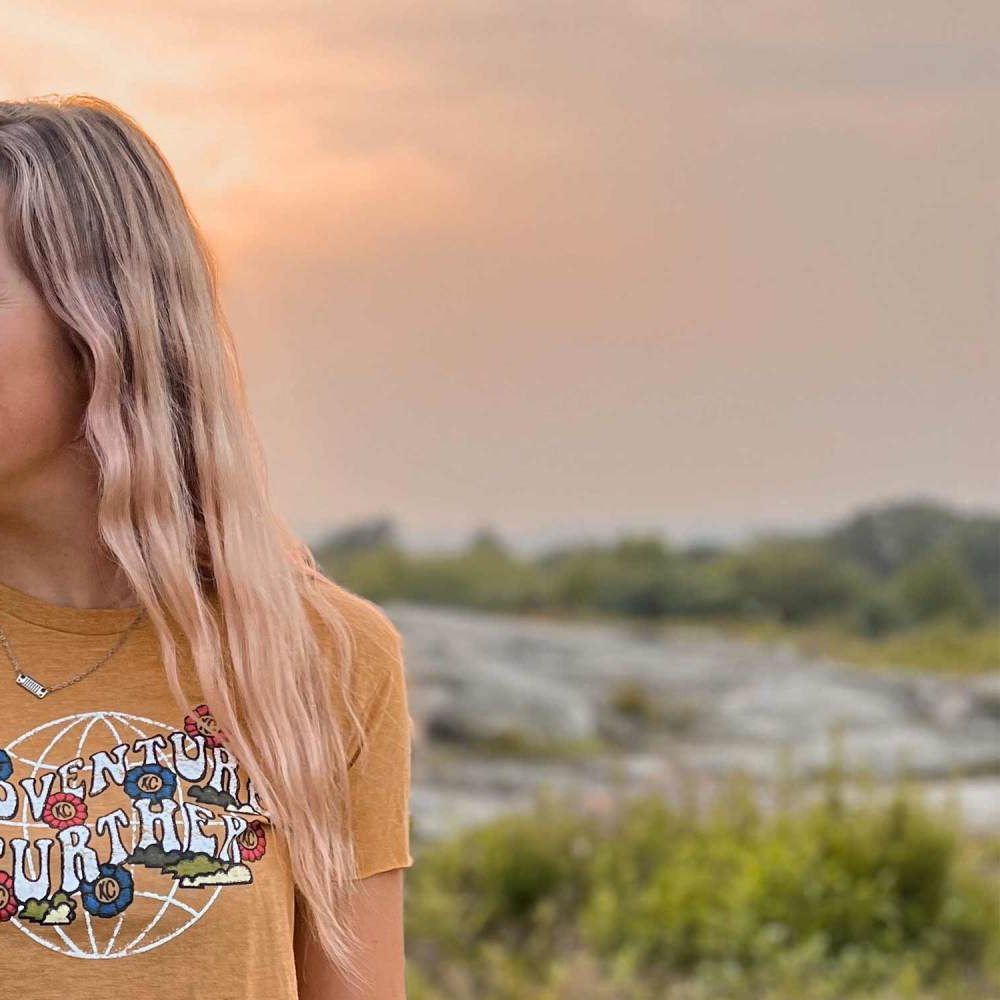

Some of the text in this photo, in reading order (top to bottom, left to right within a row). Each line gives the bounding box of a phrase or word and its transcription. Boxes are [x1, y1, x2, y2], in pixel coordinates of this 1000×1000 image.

[141, 776, 160, 791] KC
[53, 804, 73, 819] KC
[98, 877, 117, 901] KC
